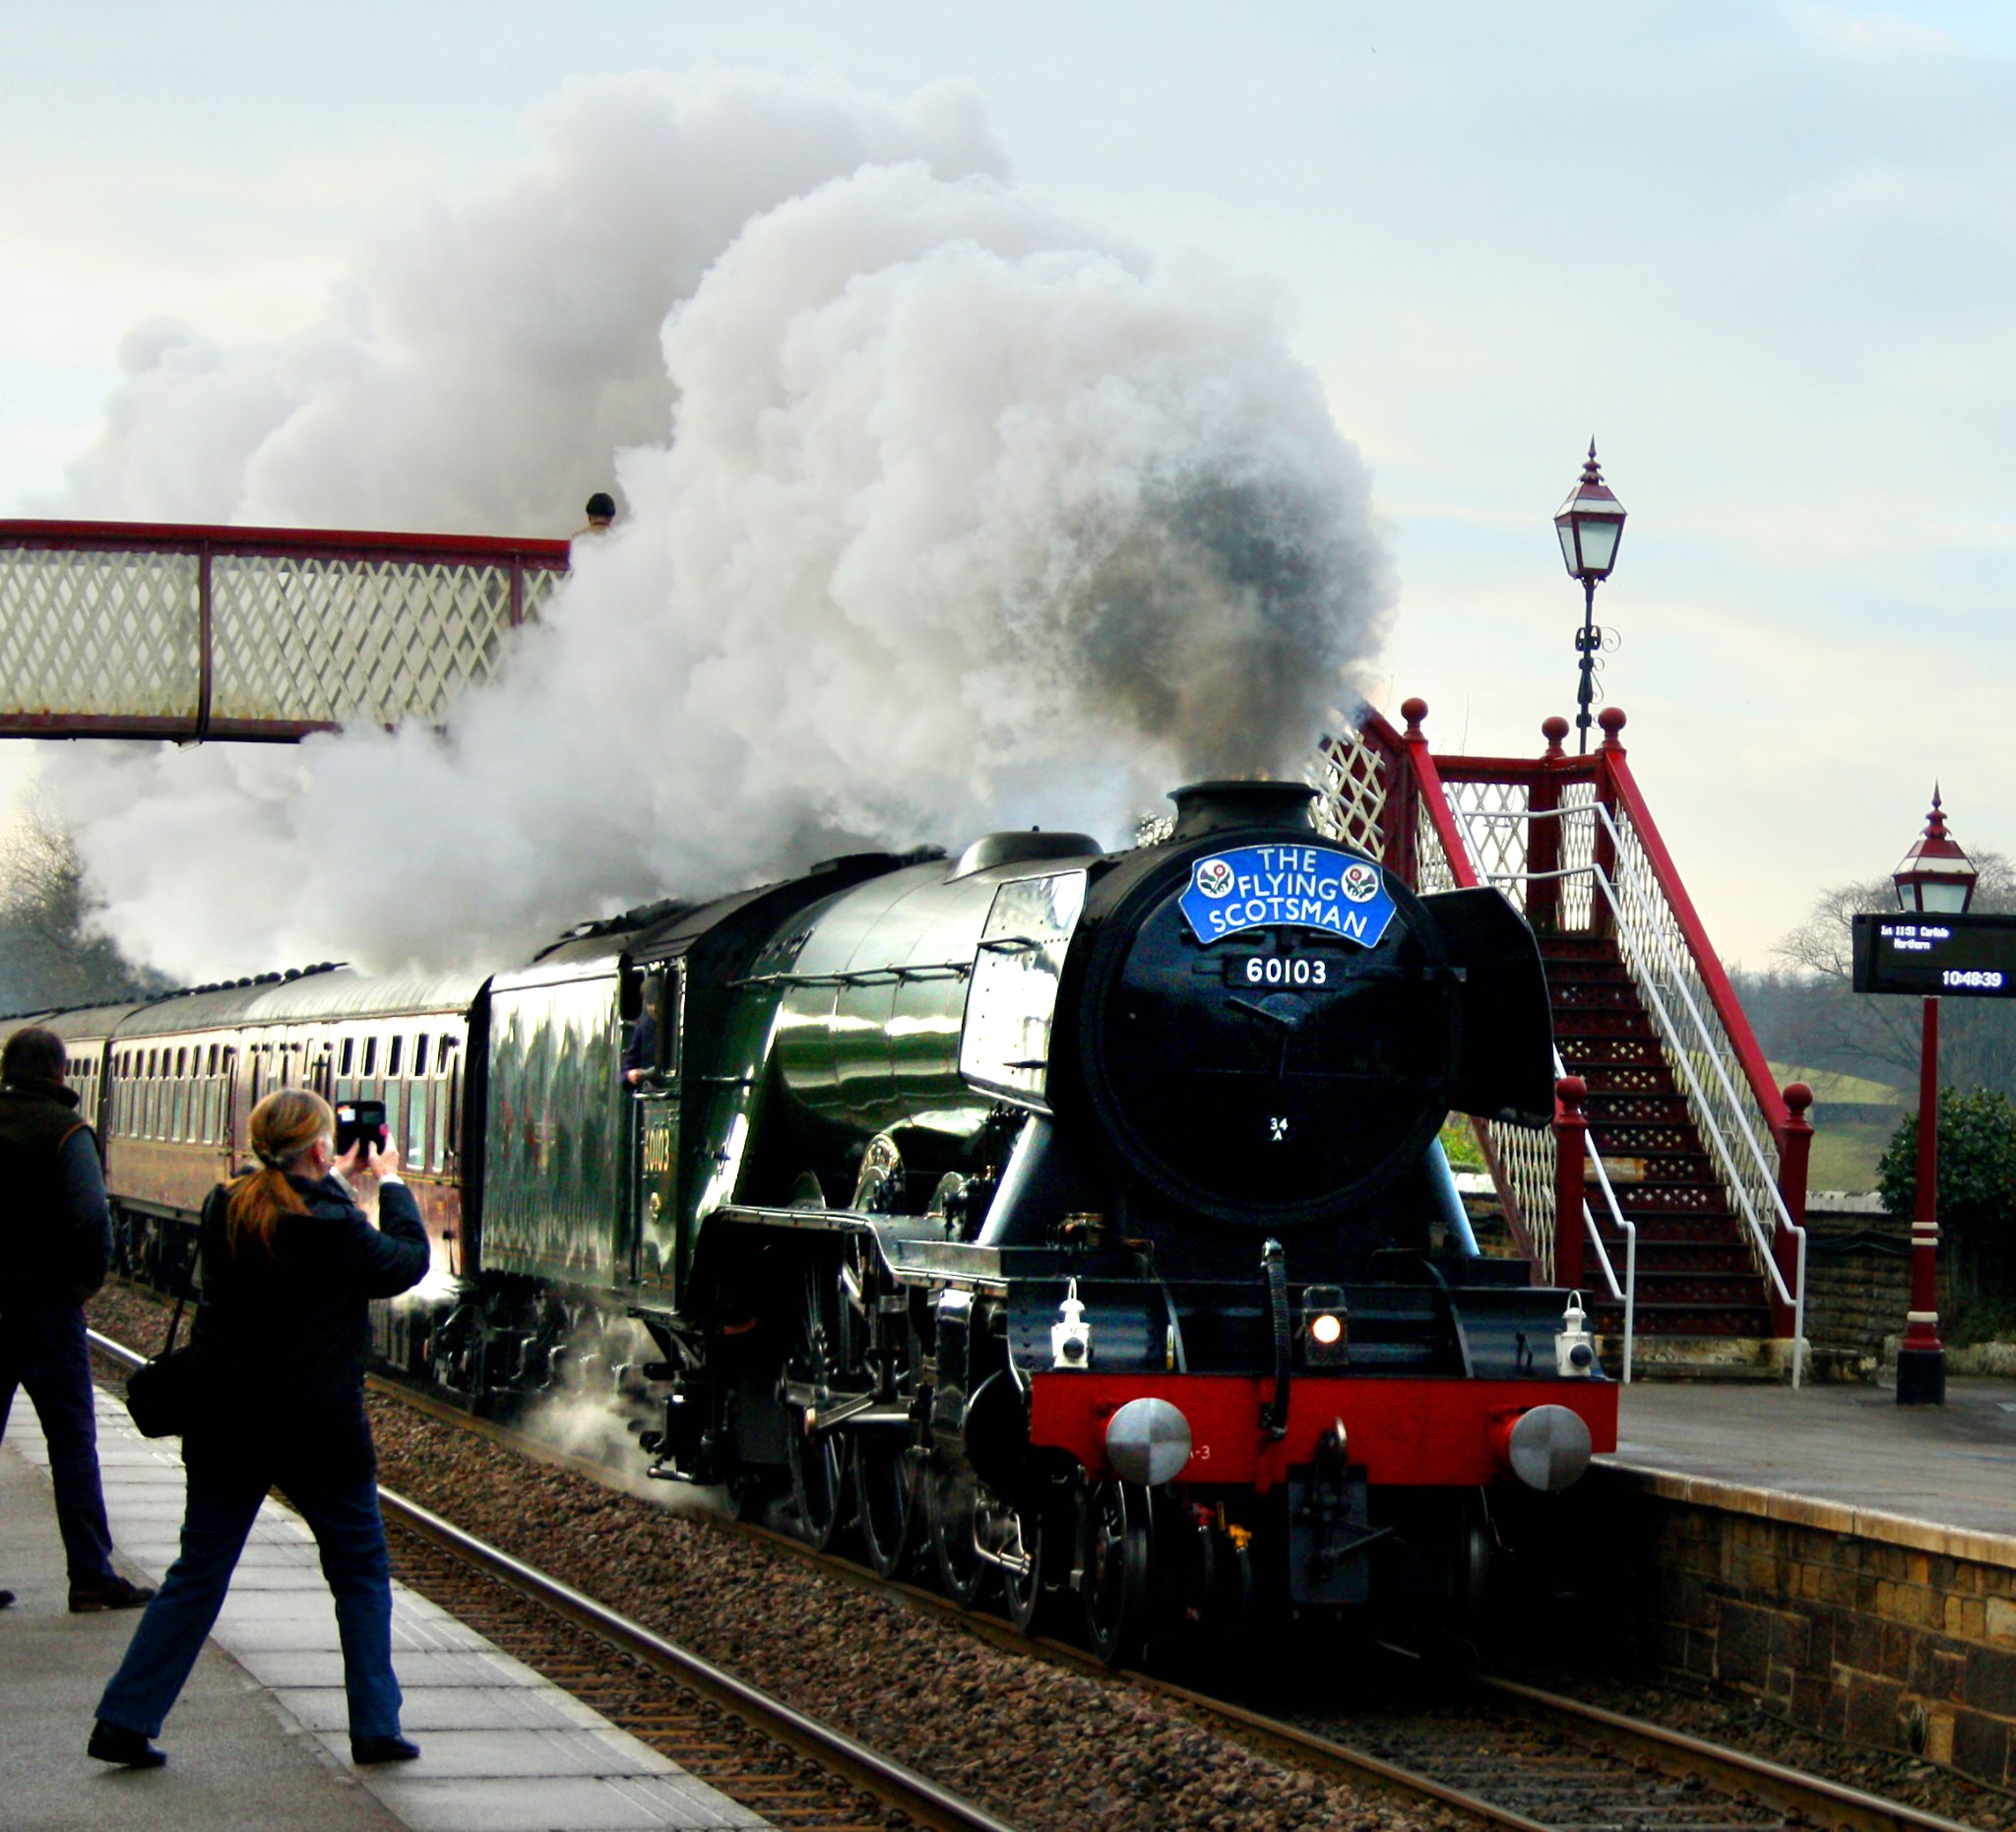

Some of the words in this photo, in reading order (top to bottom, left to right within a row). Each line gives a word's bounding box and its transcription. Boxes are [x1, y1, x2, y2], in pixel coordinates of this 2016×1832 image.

[1256, 848, 1317, 872] THE
[1237, 872, 1340, 901] FLYING
[1209, 897, 1367, 938] SCOTSMAN
[1246, 958, 1326, 983] 60103
[1943, 971, 2001, 986] 10:48:39
